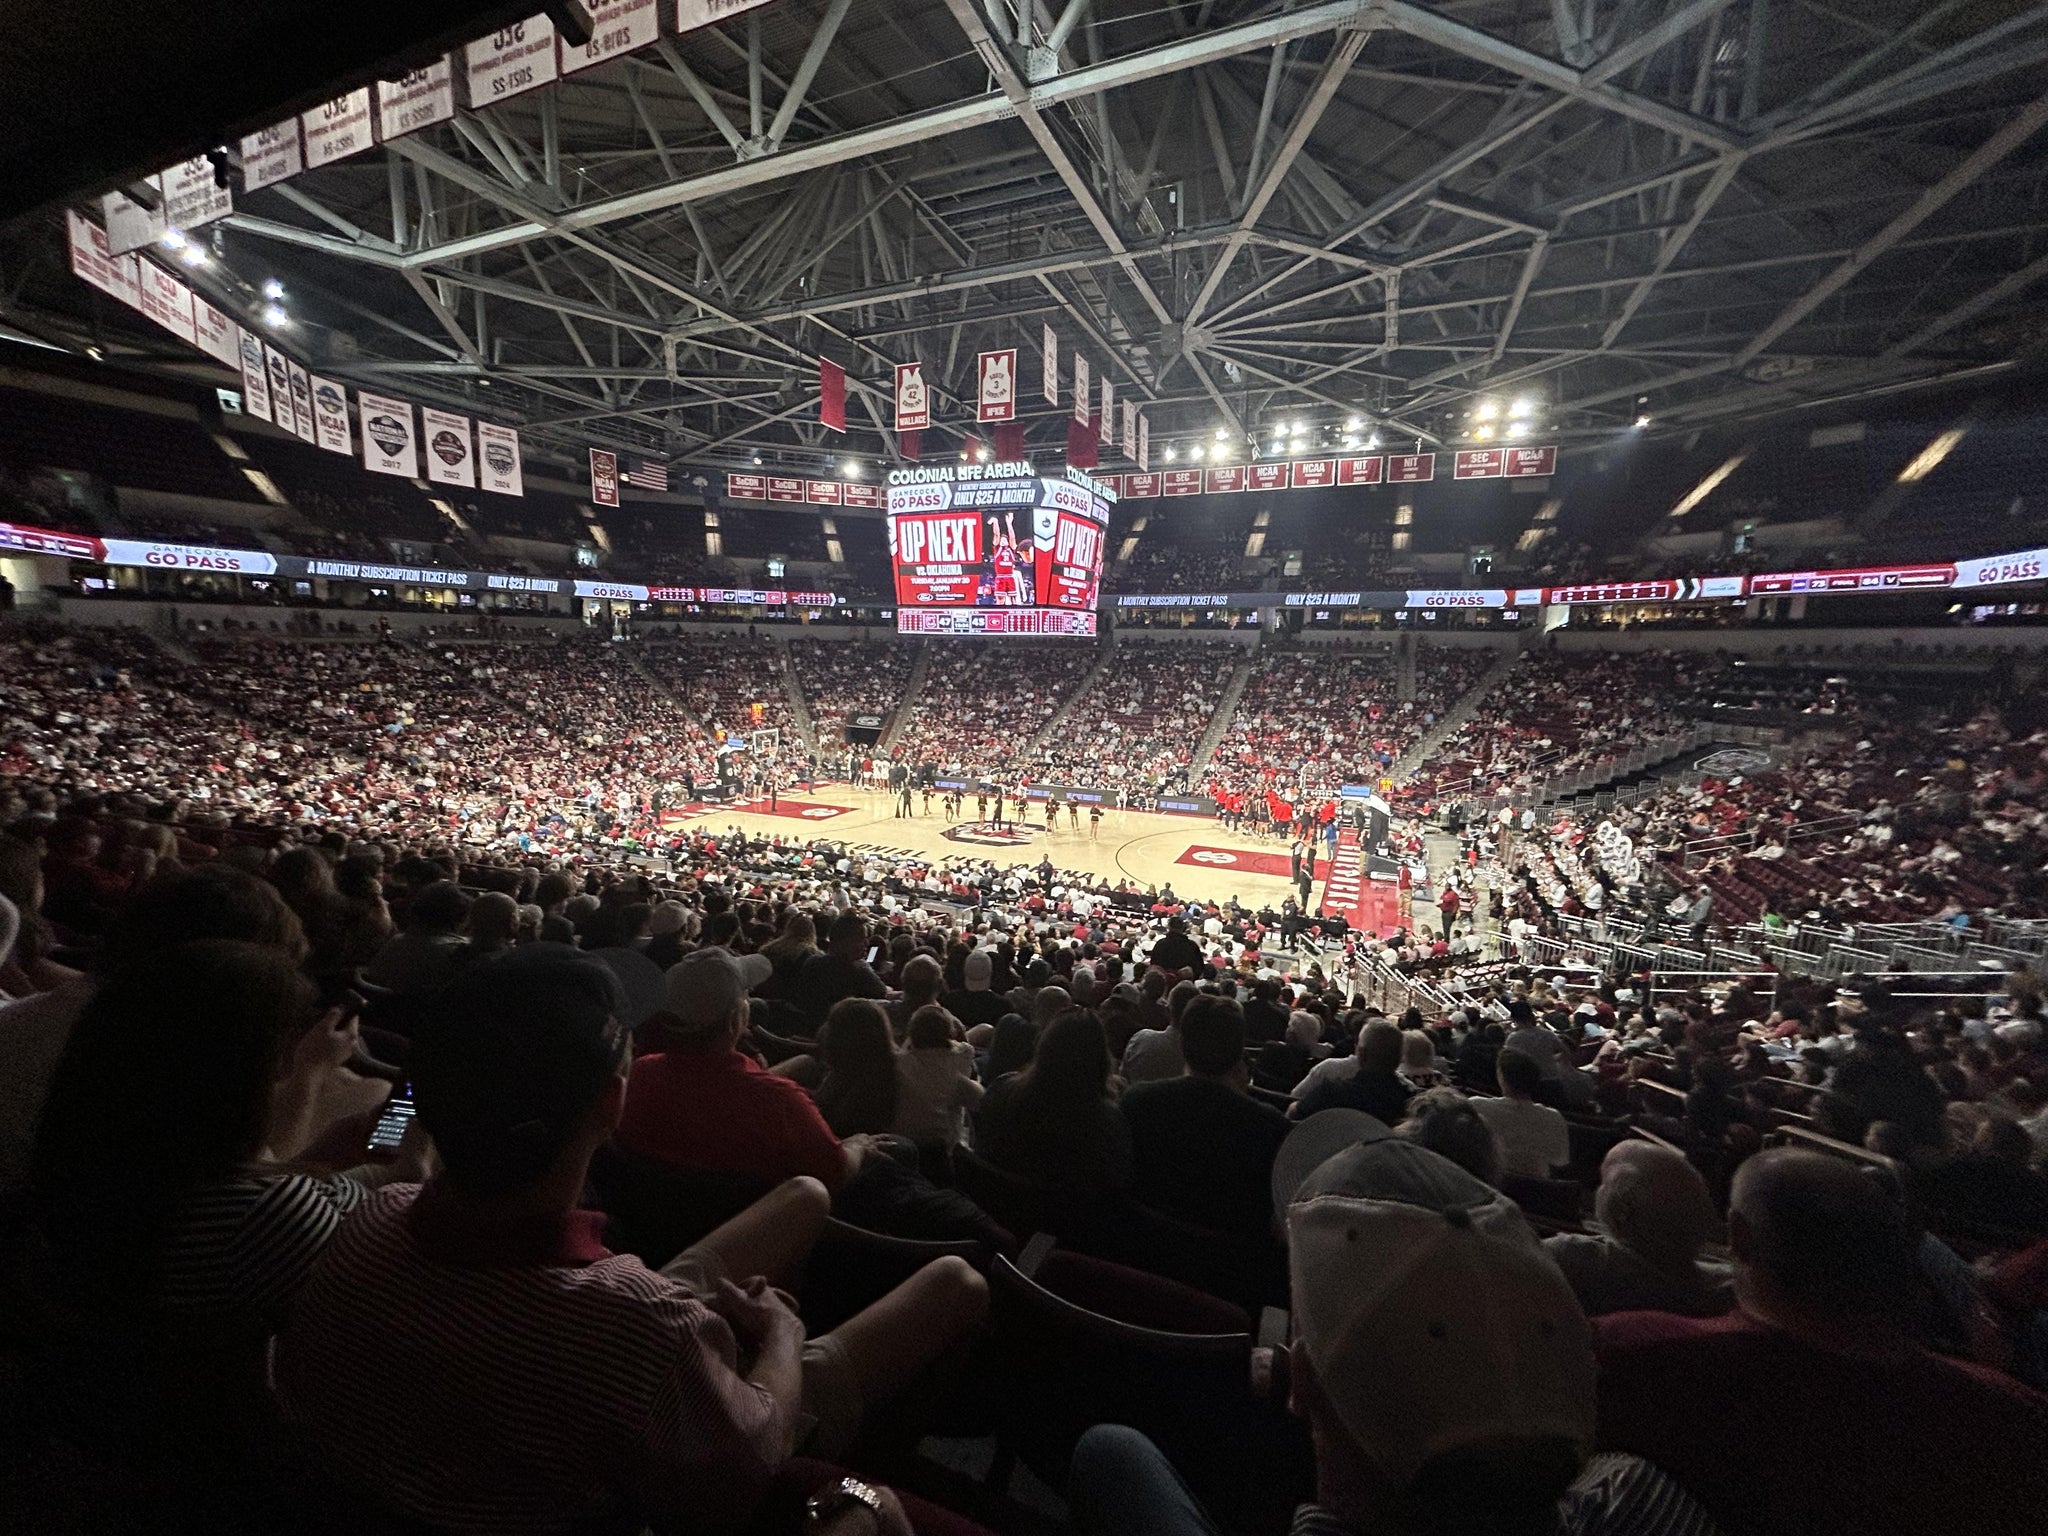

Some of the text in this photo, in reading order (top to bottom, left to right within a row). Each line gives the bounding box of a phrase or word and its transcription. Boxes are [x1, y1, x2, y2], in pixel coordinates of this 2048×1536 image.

[993, 381, 1000, 390] 3
[907, 391, 917, 400] 42
[318, 412, 347, 433] NCAA
[898, 415, 927, 426] WALLACE
[1470, 452, 1490, 464] SEC
[1516, 449, 1545, 461] NCAA
[381, 459, 401, 470] 2017
[1302, 462, 1326, 474] NCAA
[1353, 460, 1369, 471] NIT
[1403, 457, 1419, 468] NIT
[443, 470, 461, 480] 2022
[888, 461, 1034, 485] COLONIAL LIFE ARENA
[1175, 472, 1190, 482] SEC
[1214, 469, 1236, 480] NCAA
[1257, 466, 1279, 477] NCAA
[494, 479, 511, 489] 2024
[595, 477, 616, 490] NCAA
[735, 477, 759, 487] SoCON
[1066, 465, 1094, 493] COLONIAL
[1133, 475, 1153, 485] NCAA
[774, 480, 797, 490] SoCON
[812, 483, 835, 493] SoCON
[850, 486, 873, 496] SoCON
[894, 488, 936, 497] GAMECOCK
[891, 495, 942, 510] GO PASS
[953, 488, 1036, 506] ONLY $25 A MONTH
[1055, 492, 1089, 512] GO PASS
[900, 518, 977, 563] UP NEXT
[1056, 519, 1099, 569] UP NEXT
[153, 544, 231, 557] GAMECOCK
[145, 551, 241, 570] GO PASS
[307, 561, 468, 585] A MONTHLY SUBSCRIPTION TICKET PASS
[926, 564, 963, 575] OKLAHOMA
[1978, 561, 2041, 583] GO PASS
[487, 575, 559, 592] ONLY $25 A MONTH
[1811, 580, 1826, 588] 73
[592, 587, 634, 599] GO PASS
[723, 592, 735, 600] 47
[1118, 595, 1228, 606] A MONTHLY SUBSCRIPTION TICKET PASS
[1285, 593, 1361, 606] ONLY $25 A MONTH
[1425, 596, 1486, 606] GO PASS
[939, 617, 952, 626] 47
